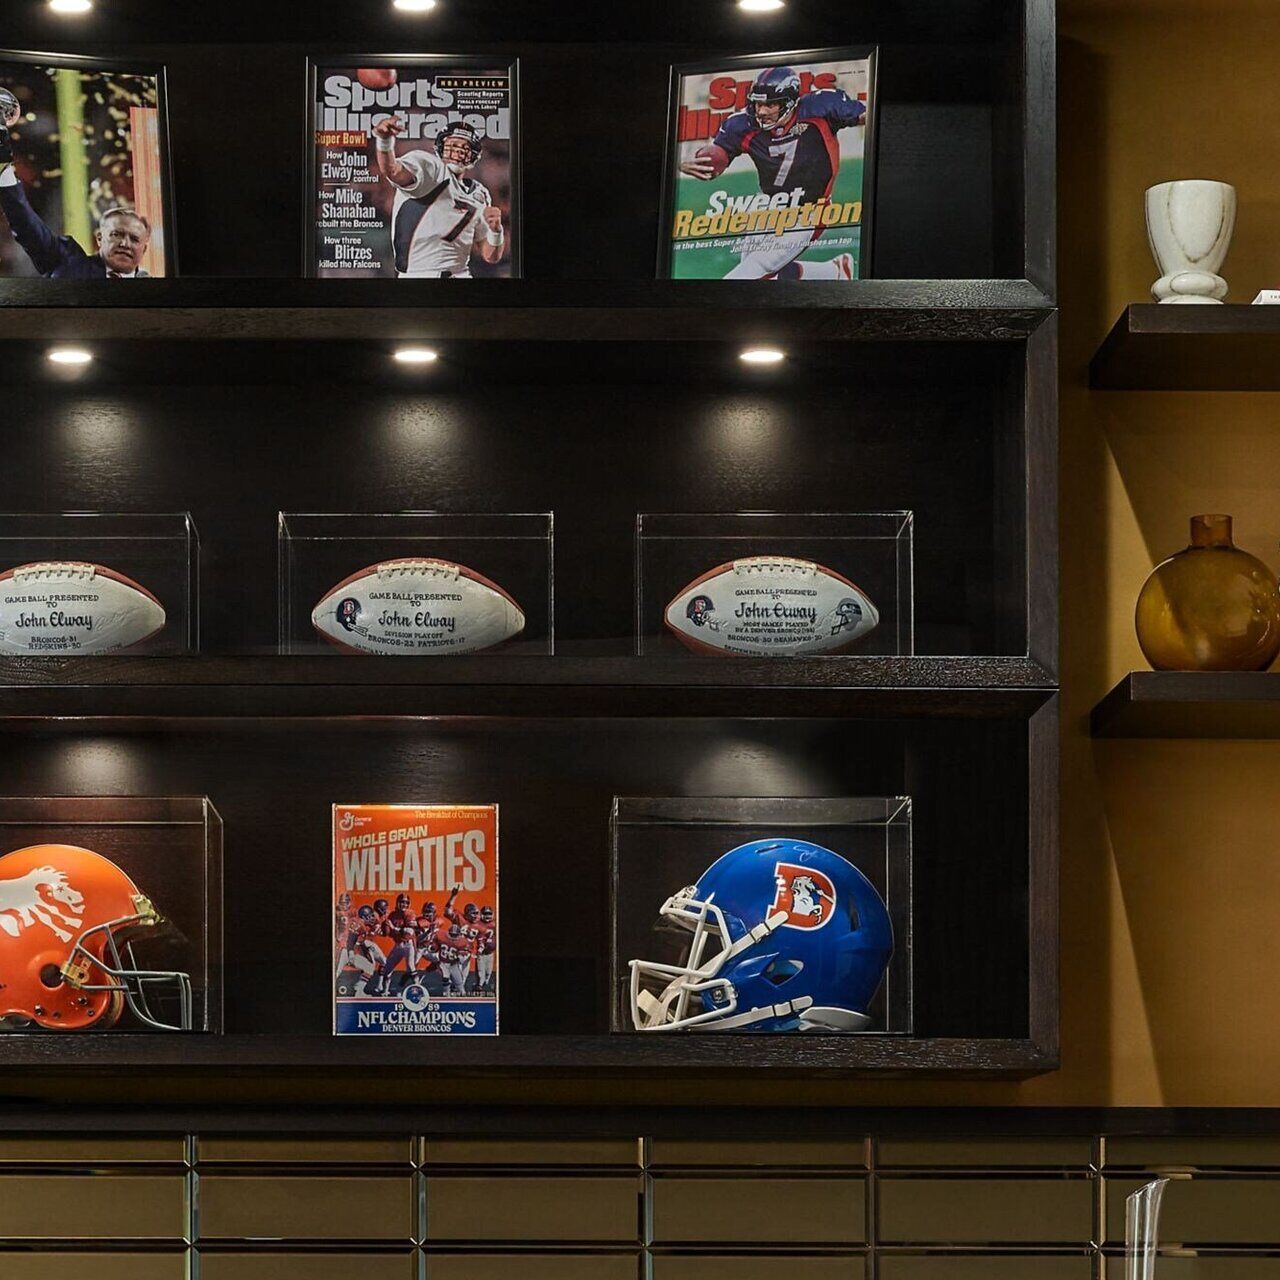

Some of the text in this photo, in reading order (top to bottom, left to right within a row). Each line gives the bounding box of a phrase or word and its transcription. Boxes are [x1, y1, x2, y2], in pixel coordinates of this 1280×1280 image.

[324, 75, 454, 111] Sports
[315, 132, 365, 146] Super Bowl
[326, 151, 368, 167] How John
[768, 138, 799, 188] 7
[321, 162, 352, 182] Elway
[353, 168, 369, 176] took
[318, 189, 363, 204] How Mike
[707, 186, 805, 219] Sweet
[322, 204, 376, 218] Shanahan
[673, 195, 863, 239] Redemption
[340, 220, 352, 228] the
[353, 220, 384, 228] Broncos
[324, 236, 362, 244] How three
[696, 241, 713, 249] best
[334, 245, 373, 260] Blitzes
[318, 260, 381, 268] killed the Falcons
[5, 596, 26, 604] GAME
[50, 594, 100, 602] PRESENTED
[369, 592, 390, 600] GAME
[15, 612, 47, 628] John
[49, 611, 93, 630] Elway
[734, 602, 817, 624] John Elway
[378, 610, 456, 632] John Elway
[342, 825, 428, 850] WHOLE GRAIN
[341, 830, 486, 892] WHEATIES
[358, 1011, 476, 1028] NFL CHAMPIONS
[382, 1024, 452, 1032] DENVER BRONCOS
